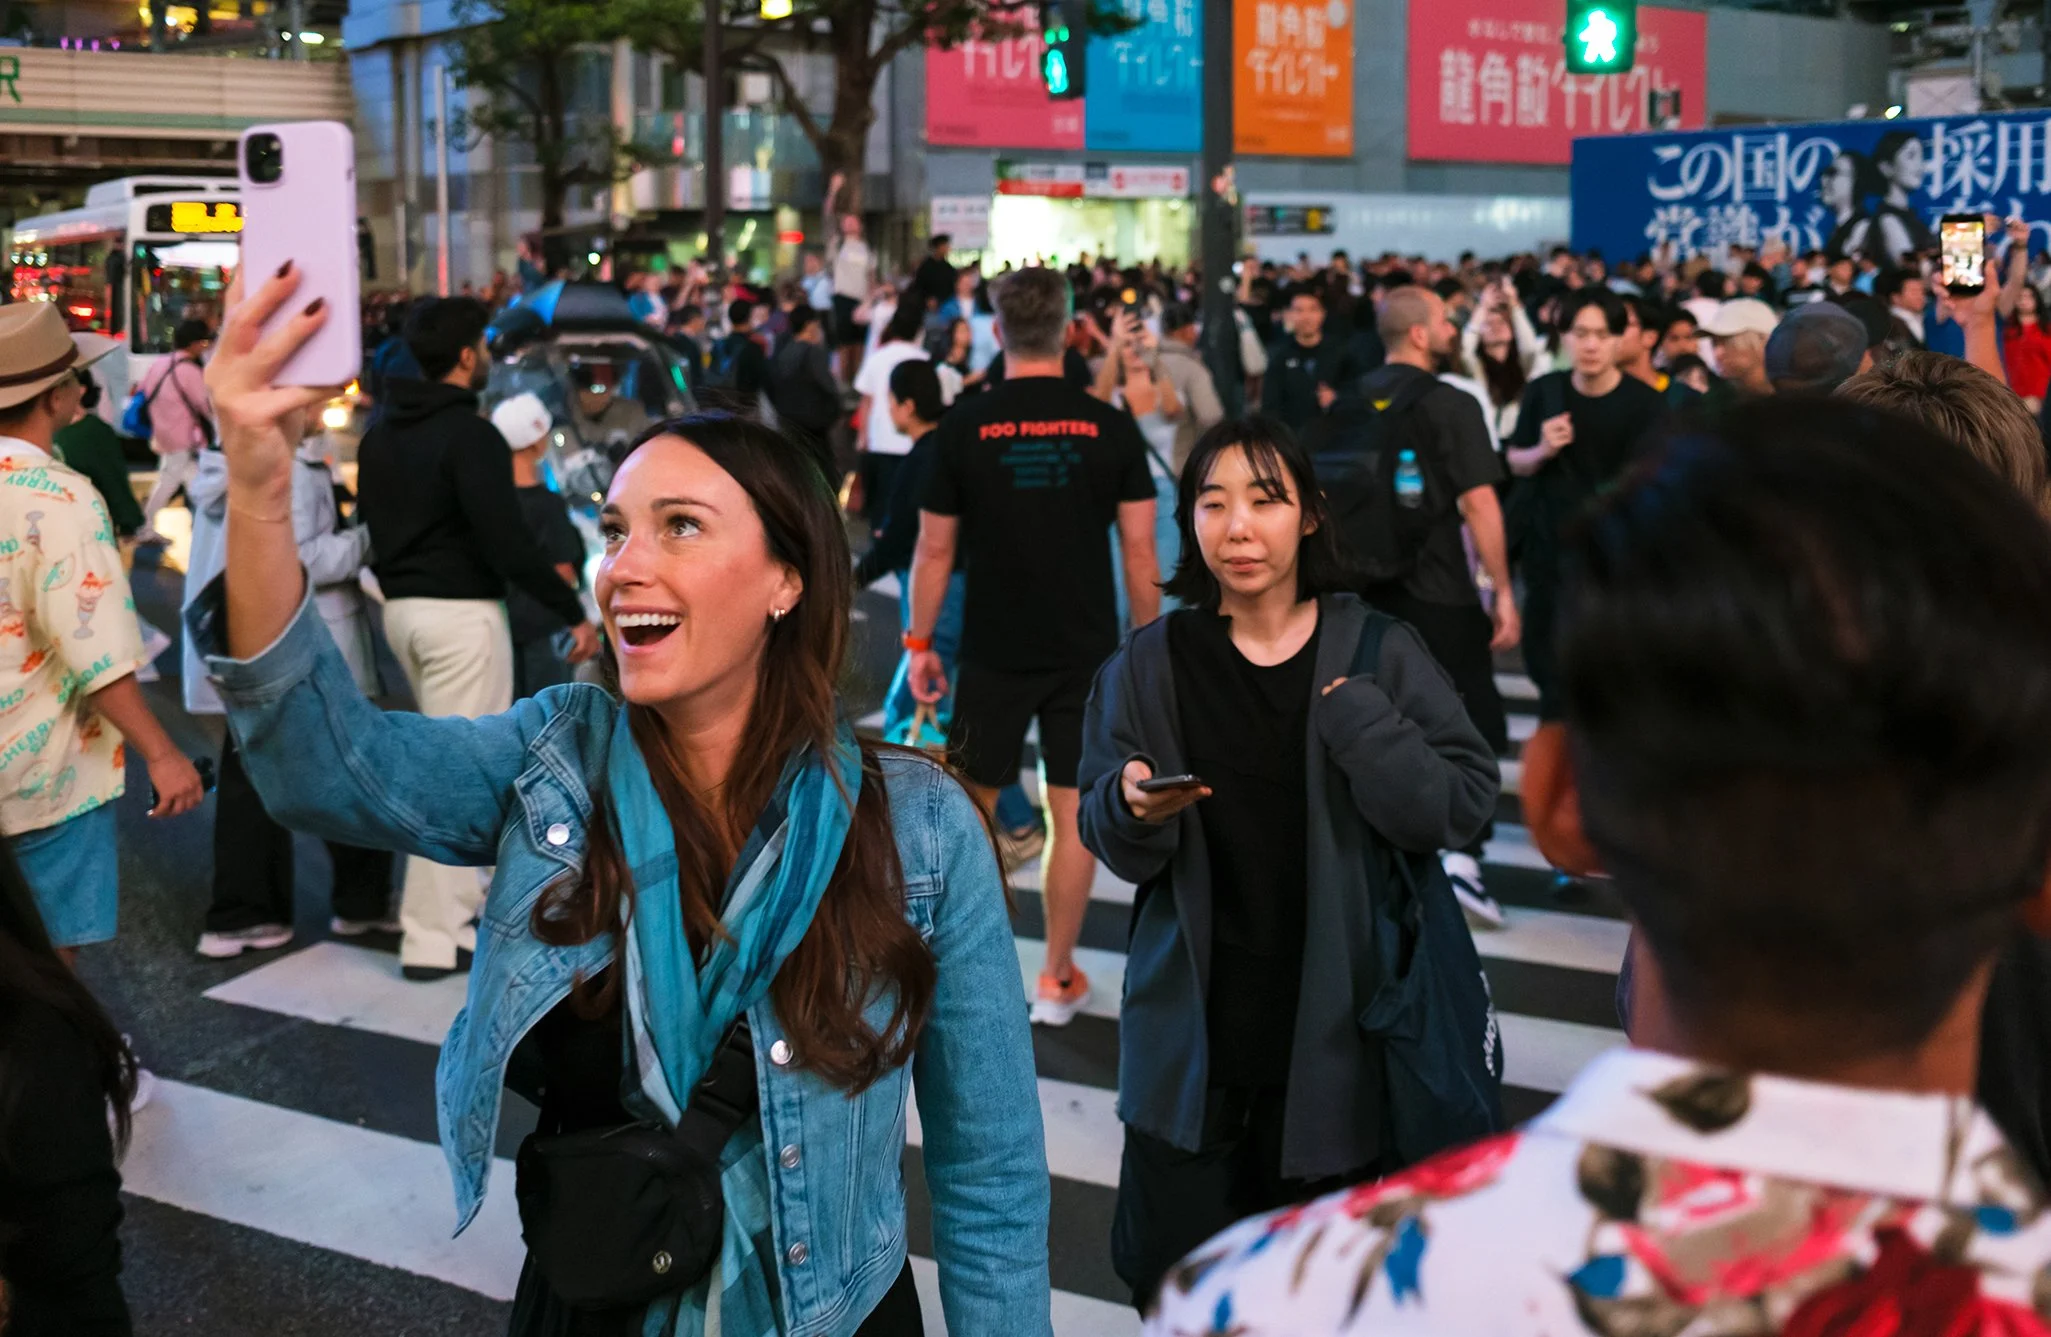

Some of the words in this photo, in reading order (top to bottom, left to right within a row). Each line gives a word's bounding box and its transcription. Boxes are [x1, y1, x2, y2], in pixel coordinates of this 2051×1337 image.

[1647, 131, 1842, 202] この国の
[979, 421, 1017, 440] FOO
[1020, 419, 1099, 438] FIGHTERS
